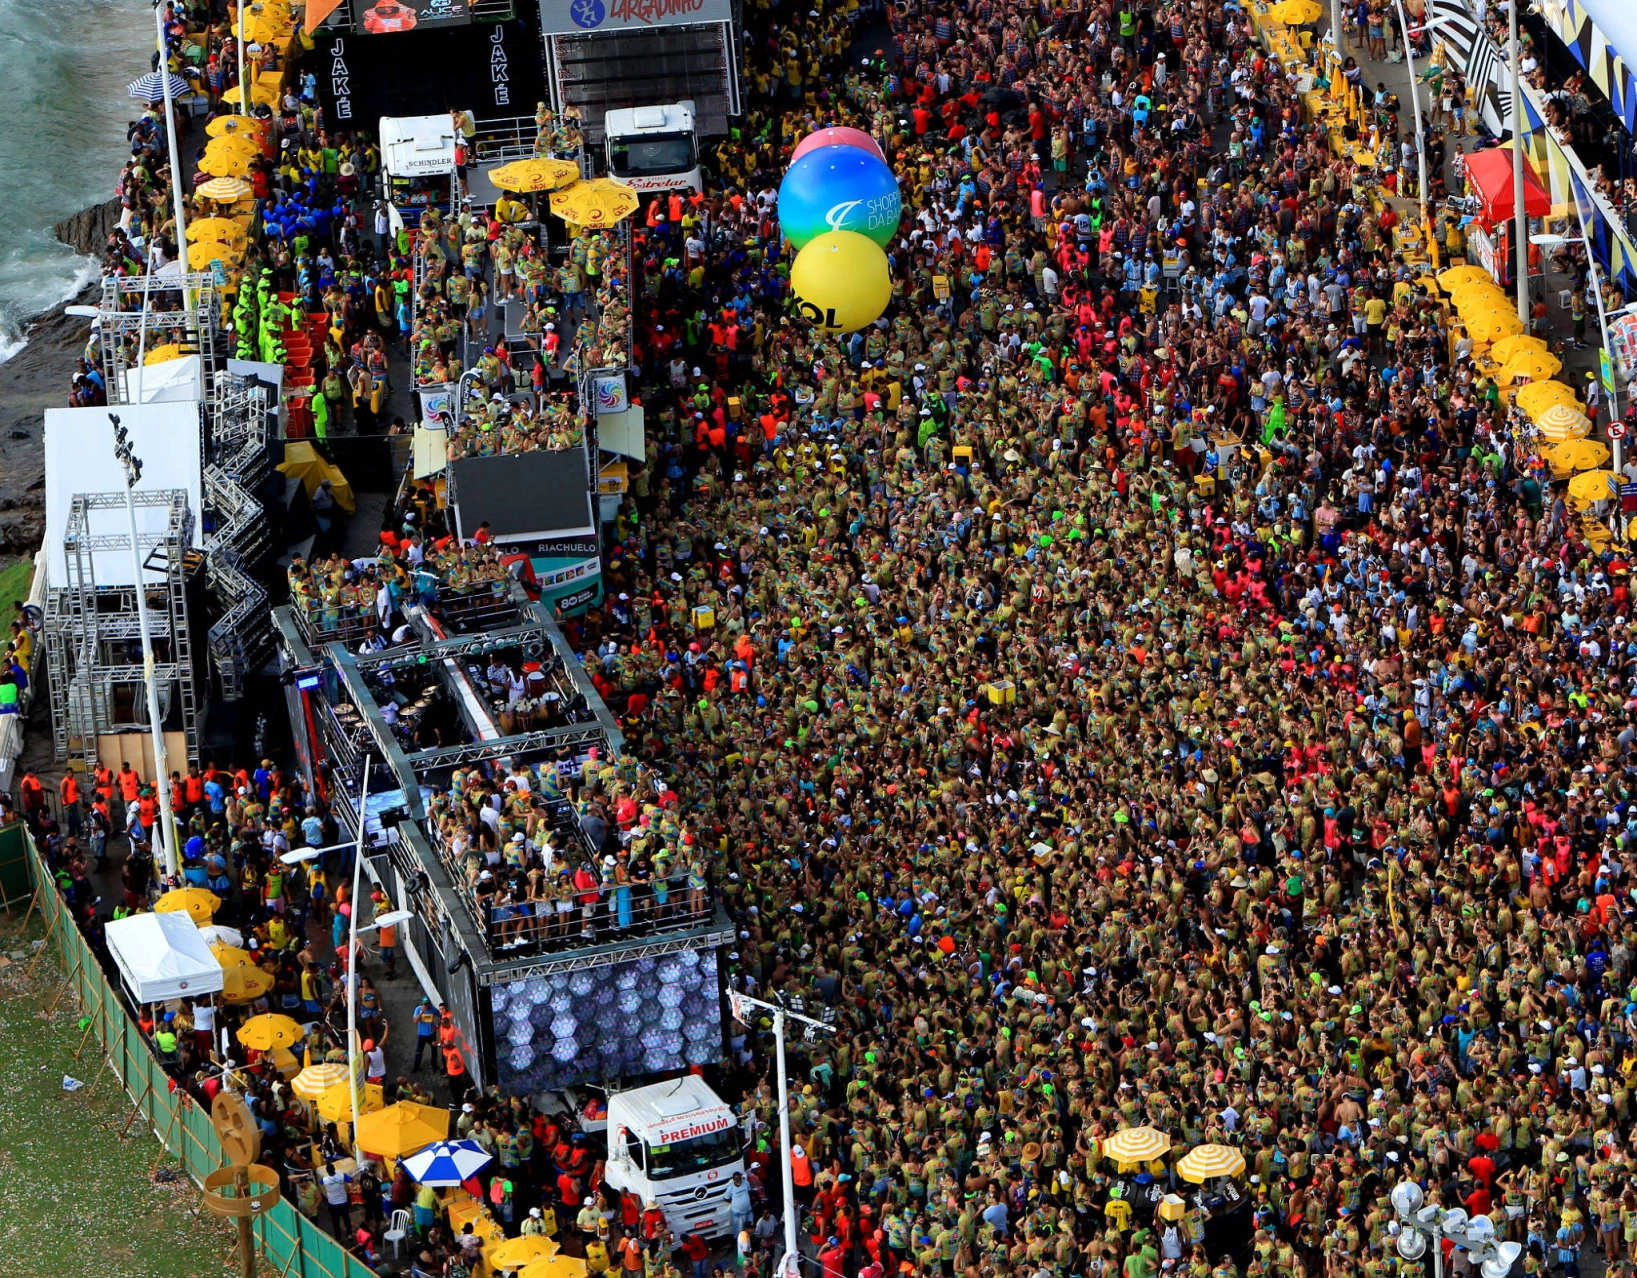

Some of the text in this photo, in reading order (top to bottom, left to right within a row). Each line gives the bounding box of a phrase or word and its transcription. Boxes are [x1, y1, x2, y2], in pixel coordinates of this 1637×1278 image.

[419, 5, 463, 15] ALICE
[490, 24, 509, 106] JAKÉ
[331, 38, 351, 119] JAKÉ
[408, 157, 453, 167] SCHINDLER
[868, 213, 885, 230] DA
[538, 543, 596, 552] RIACHUELO
[660, 1117, 729, 1144] PREMIUM
